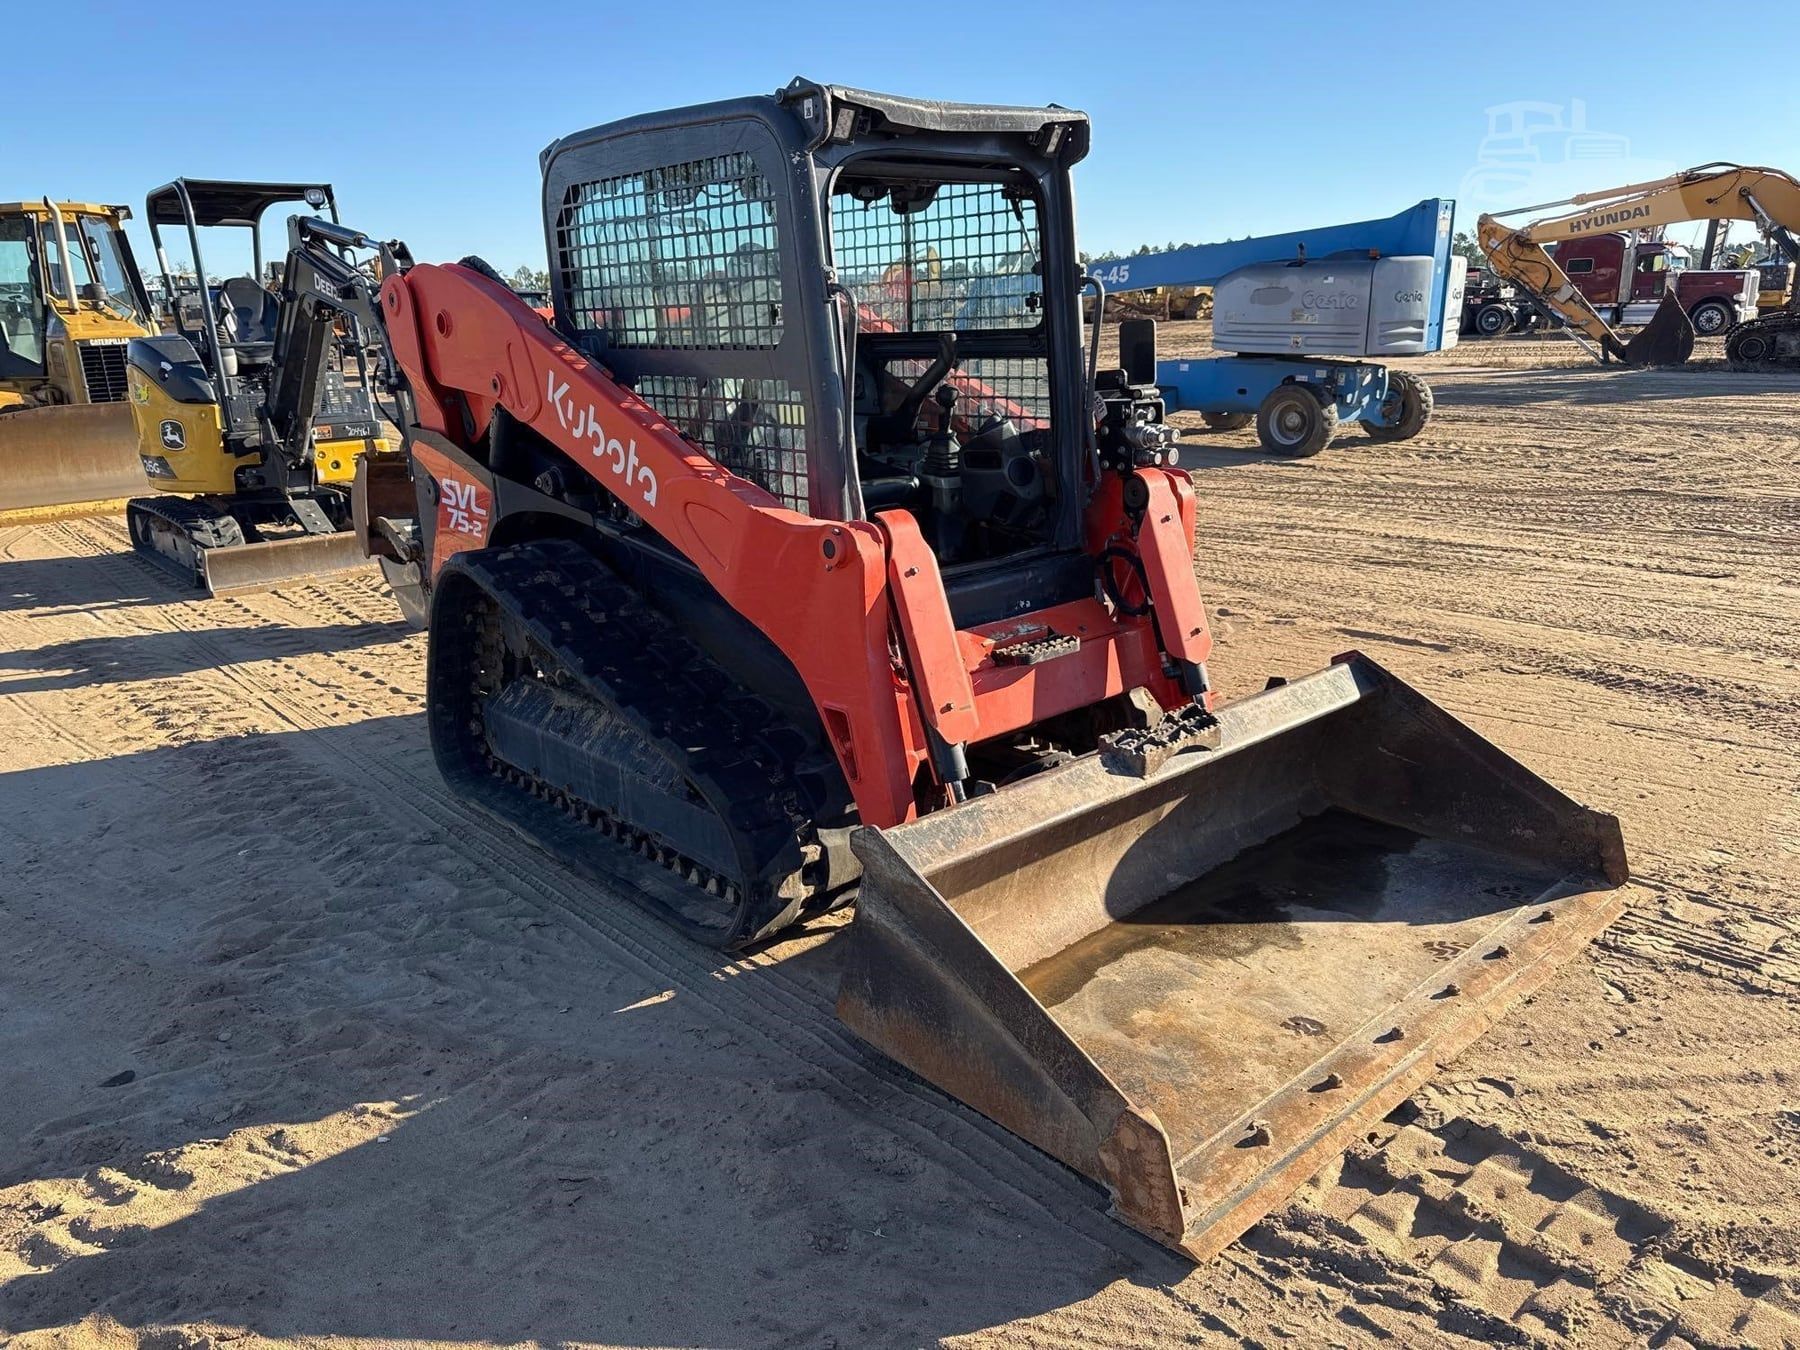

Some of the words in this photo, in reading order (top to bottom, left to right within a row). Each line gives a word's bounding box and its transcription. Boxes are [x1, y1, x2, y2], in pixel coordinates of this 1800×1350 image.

[1569, 205, 1650, 233] HYUNDAI
[1301, 289, 1360, 310] Genie
[1394, 290, 1423, 304] Genie
[547, 369, 658, 508] Kubota
[441, 478, 487, 516] SVL
[446, 506, 482, 538] 75-2
